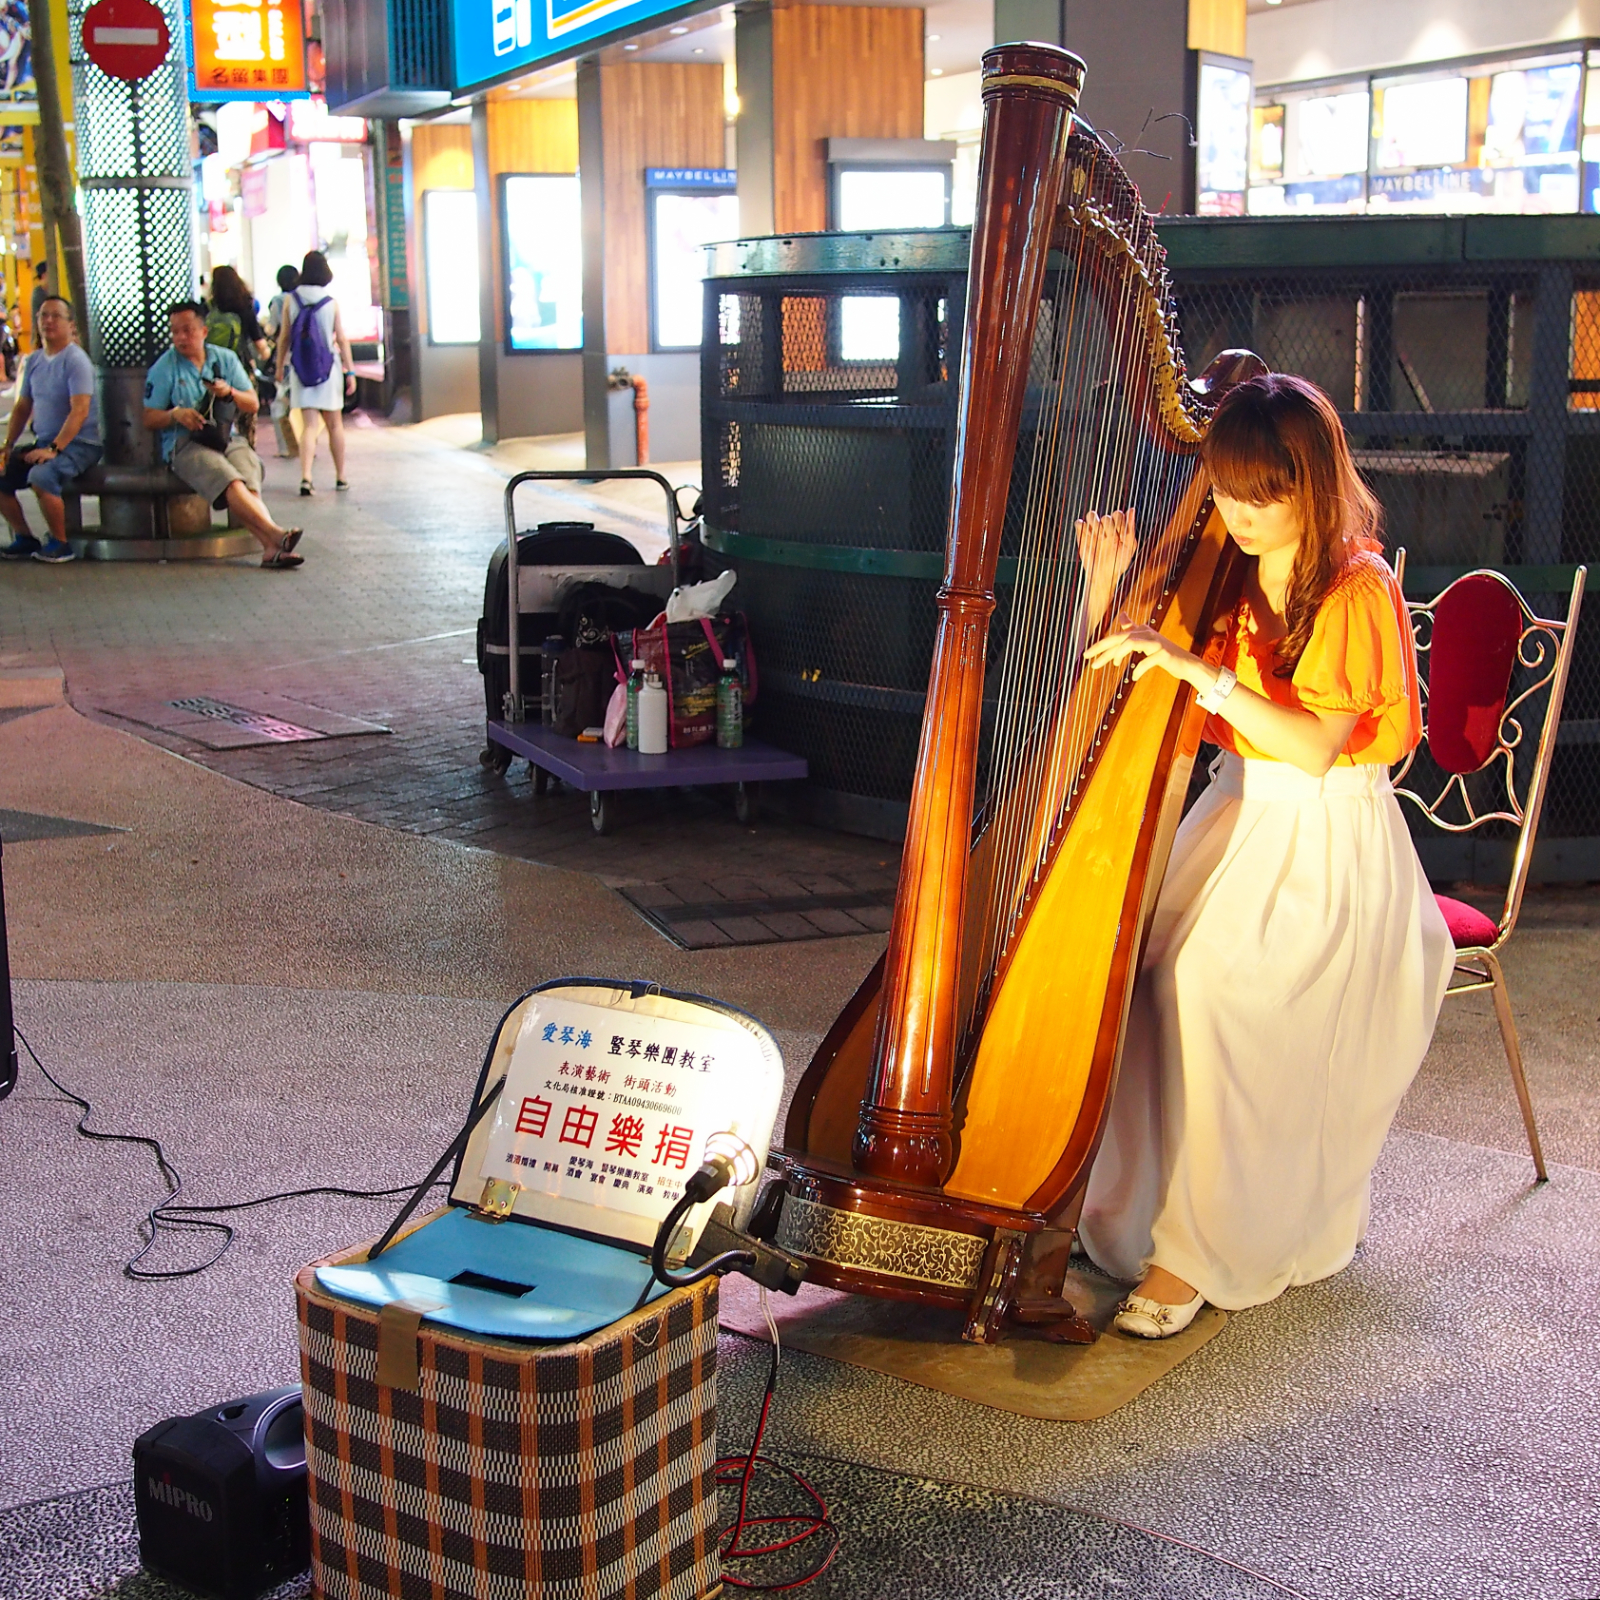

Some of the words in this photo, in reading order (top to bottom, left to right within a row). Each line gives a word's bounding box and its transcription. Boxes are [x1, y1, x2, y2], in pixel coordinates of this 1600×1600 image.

[1372, 171, 1471, 193] MAYBELLINE
[541, 1022, 593, 1050] 愛琴海
[607, 1035, 715, 1073] 豎琴樂團教室
[557, 1060, 611, 1084] 表演藝術
[623, 1074, 677, 1097] 街頭活動
[514, 1094, 694, 1170] 自由樂捐
[568, 1155, 594, 1170] 愛琴海
[657, 1176, 682, 1190] 招生中
[662, 1190, 680, 1201] 教學
[148, 1472, 213, 1522] MIPRO
